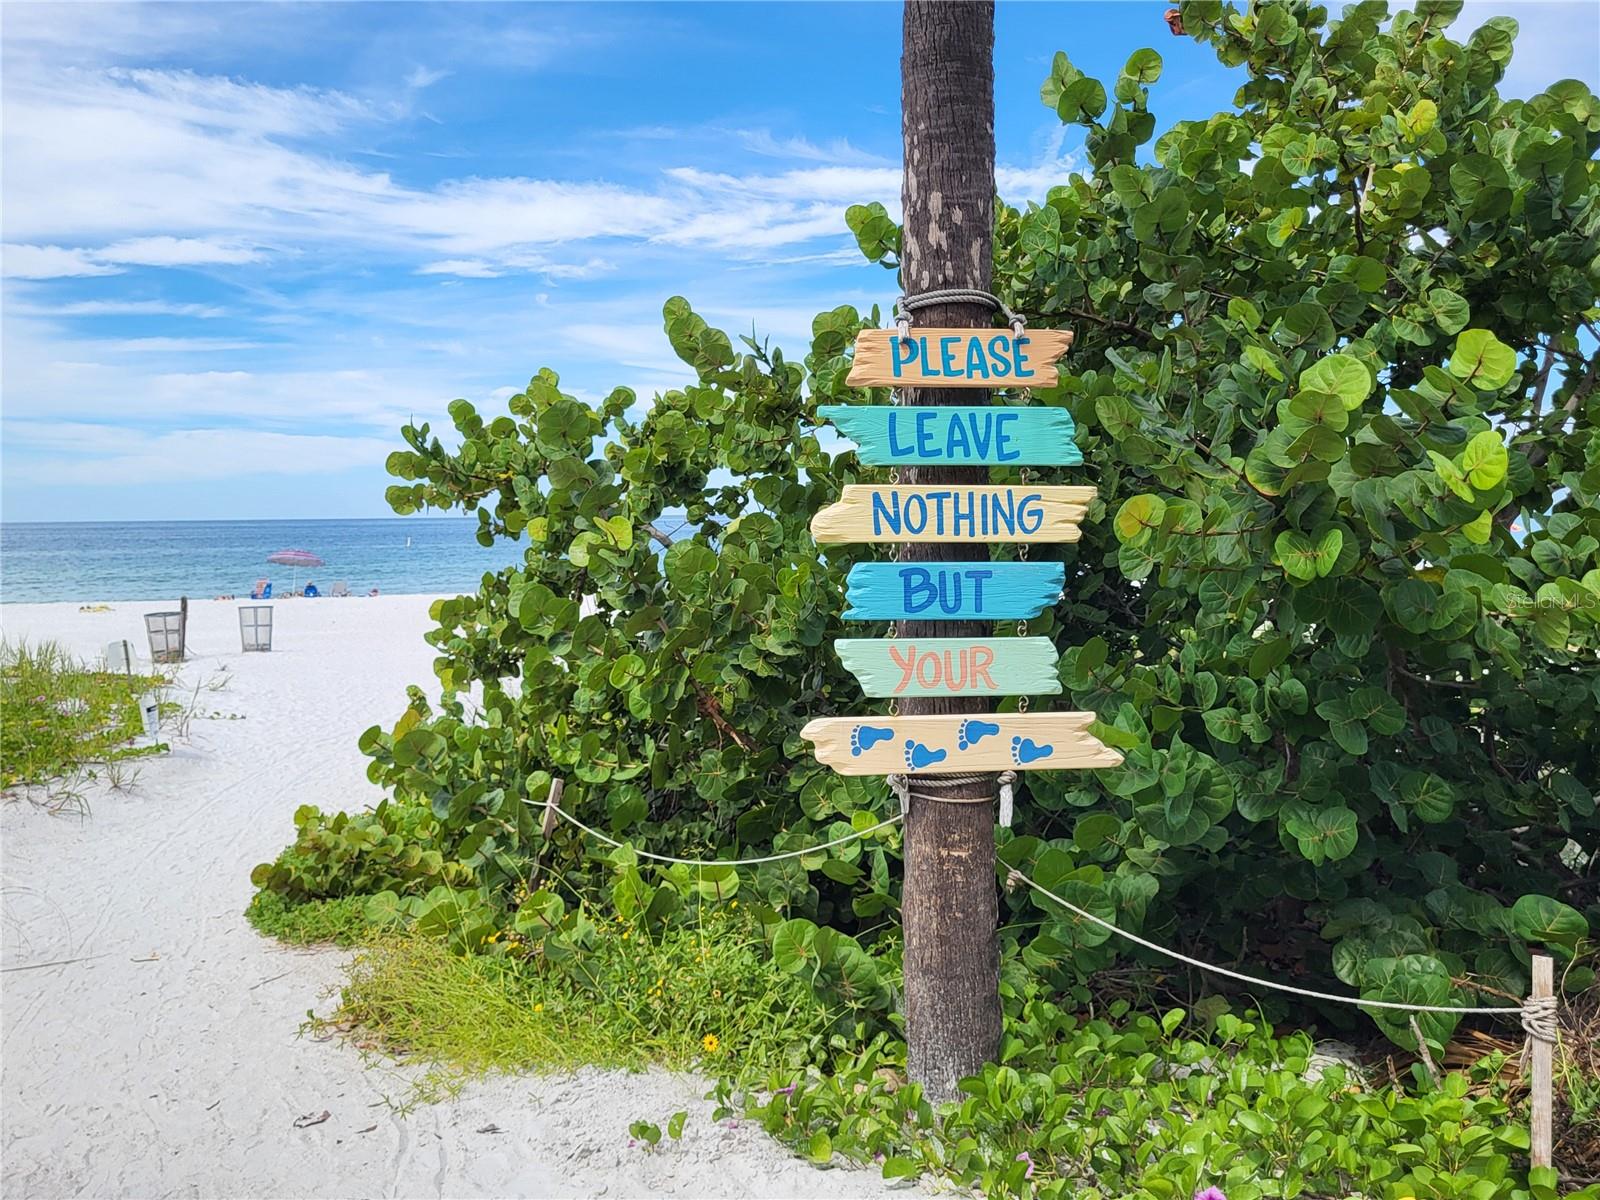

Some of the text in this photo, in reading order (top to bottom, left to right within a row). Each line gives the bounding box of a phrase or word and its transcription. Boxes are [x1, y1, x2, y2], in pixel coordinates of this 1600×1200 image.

[889, 335, 1034, 379] PLEASE
[888, 412, 1020, 462] LEAVE
[872, 489, 1044, 537] NOTHING
[899, 567, 993, 614] BUT
[889, 645, 999, 694] YOUR
